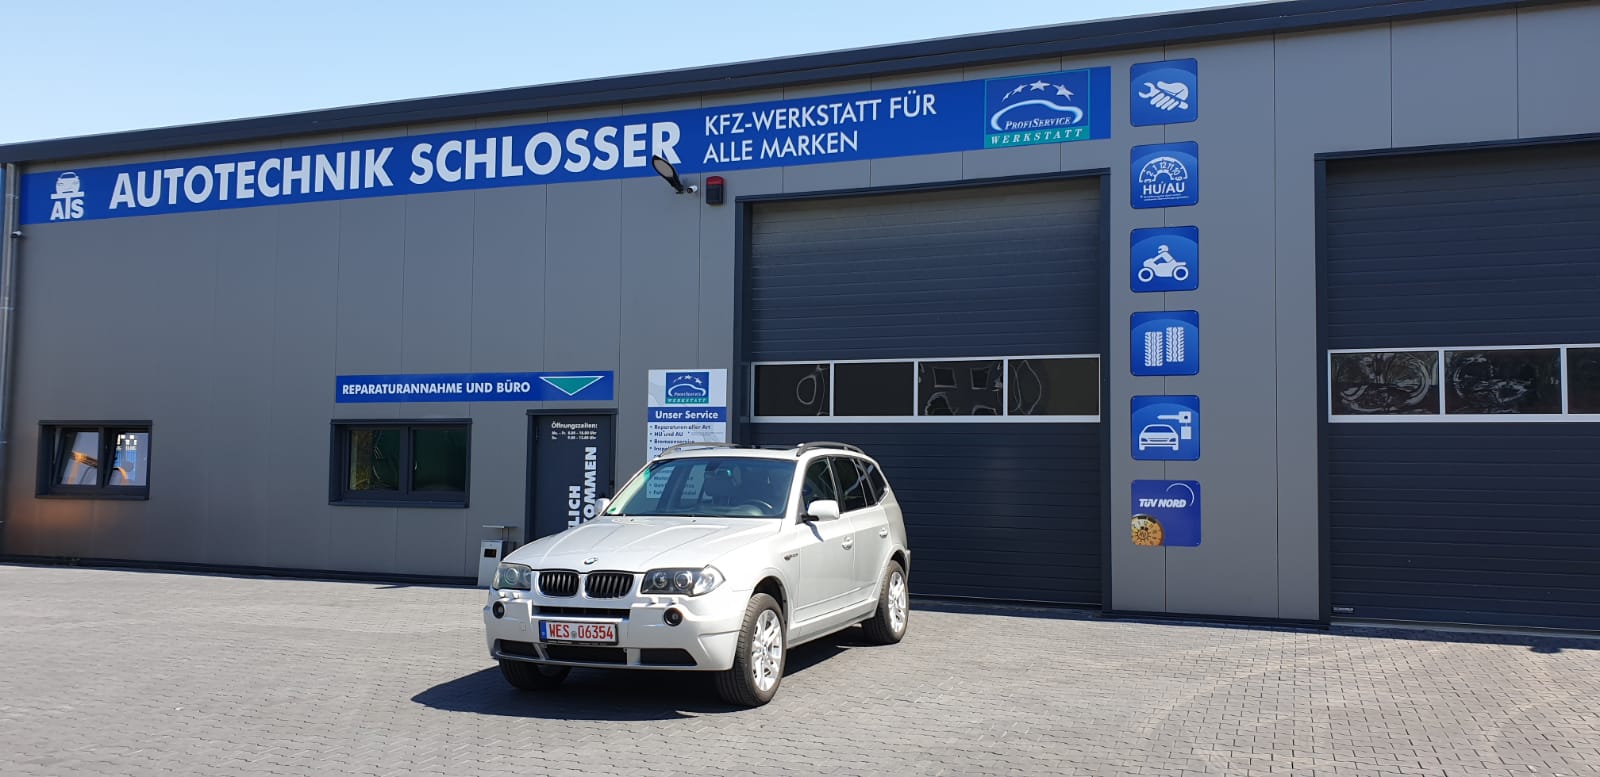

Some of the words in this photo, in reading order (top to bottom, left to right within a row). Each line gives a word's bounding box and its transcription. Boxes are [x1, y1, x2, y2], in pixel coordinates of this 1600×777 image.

[705, 99, 882, 136] KFZ-WERKSTATT
[889, 90, 937, 120] FÜR
[703, 140, 753, 164] ALLE
[759, 130, 859, 160] MARKEN
[991, 128, 1083, 145] WERKSTATT
[108, 146, 394, 210] AUTOTECHNIK
[409, 121, 681, 185] SCHLOSSER
[50, 195, 84, 220] ATS
[342, 383, 463, 395] REPARATURANNAHME
[466, 382, 493, 393] UND
[496, 379, 531, 393] BÜRO
[655, 410, 683, 419] Unser
[685, 410, 719, 419] Service
[568, 485, 581, 529] LICH
[1139, 498, 1158, 508] TÜV
[1158, 499, 1187, 508] NORD
[549, 623, 570, 638] WES
[577, 625, 614, 639] 06354
